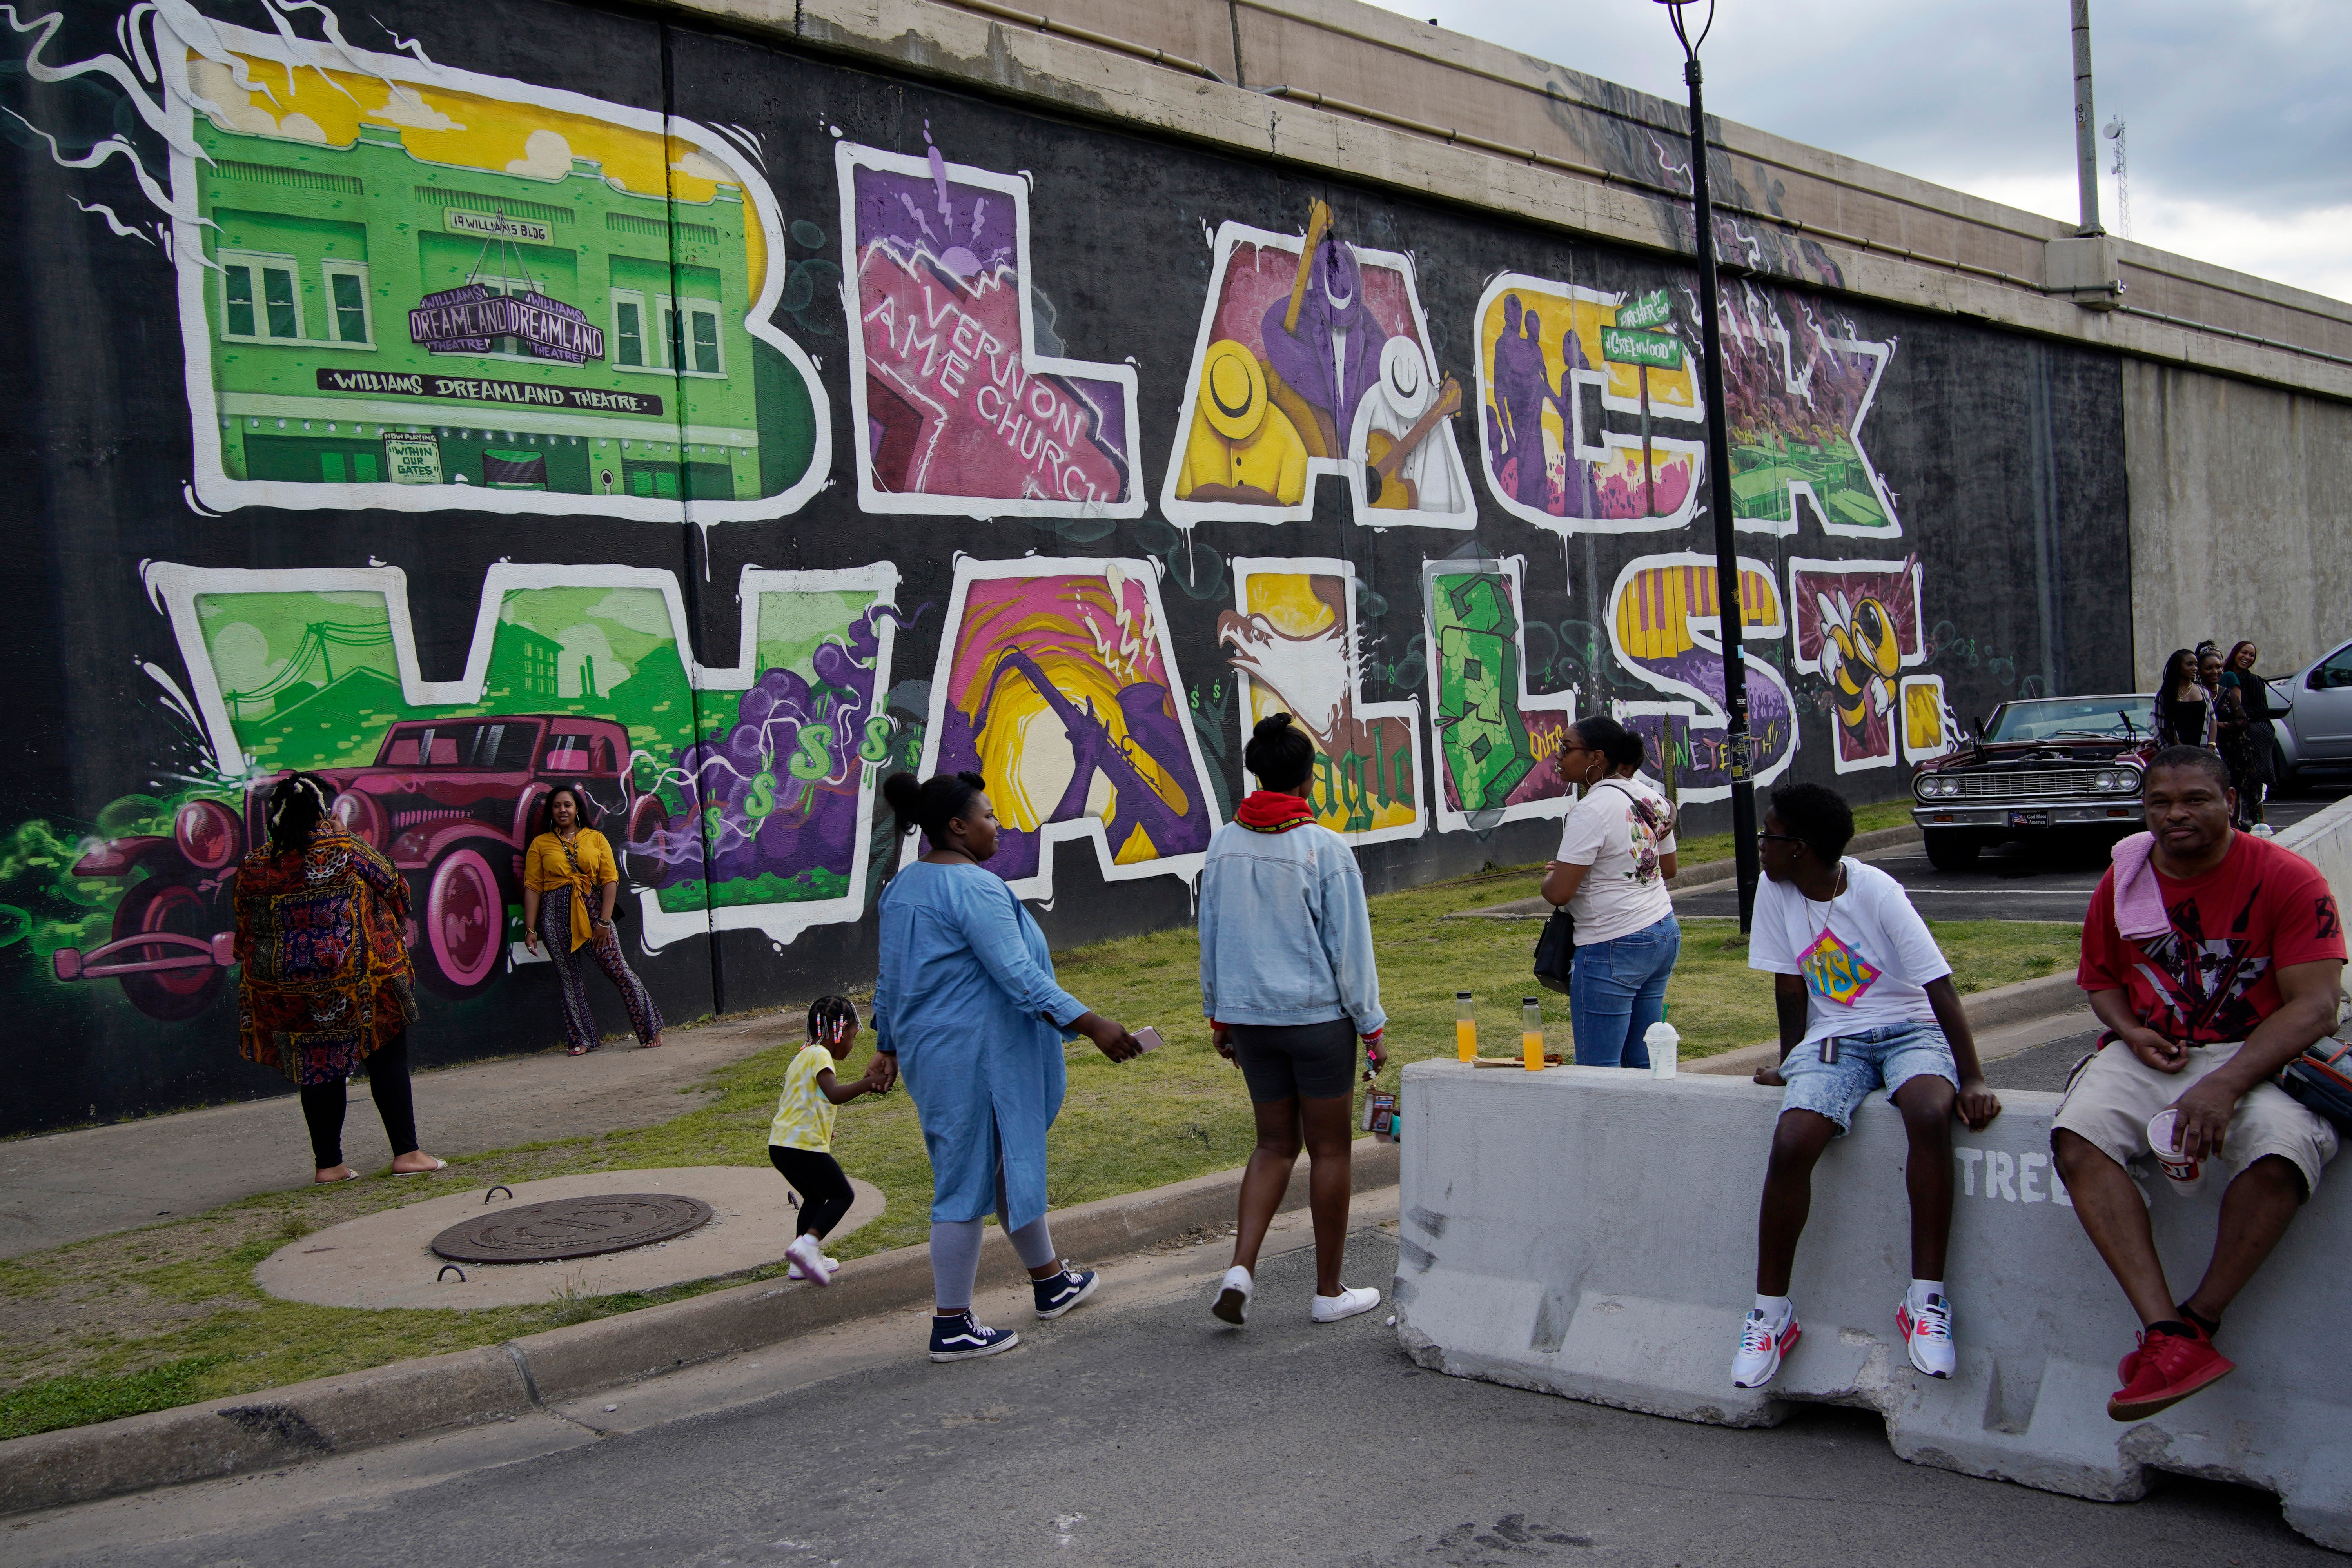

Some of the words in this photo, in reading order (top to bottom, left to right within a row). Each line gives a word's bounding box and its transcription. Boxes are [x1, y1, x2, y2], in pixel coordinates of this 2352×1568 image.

[465, 218, 517, 235] WILLIAMS
[521, 225, 545, 240] BLDG
[411, 301, 507, 340] DREAMLAND
[1620, 296, 1659, 327] ARCHER
[1650, 289, 1662, 307] ST
[1657, 302, 1669, 317] 500
[511, 302, 603, 356] DREAMLAND
[864, 296, 969, 398] AME
[1611, 331, 1669, 359] GREENWOOD
[1669, 339, 1678, 351] AV
[923, 286, 1081, 447] VERNON
[333, 372, 423, 394] WILLIAMS
[435, 379, 564, 405] DREAMLAND
[570, 390, 640, 411] THEATRE
[977, 386, 1107, 517] CHURCH
[1493, 760, 1525, 795] BAND
[1800, 942, 1872, 997] RISE
[2160, 1163, 2190, 1179] QT
